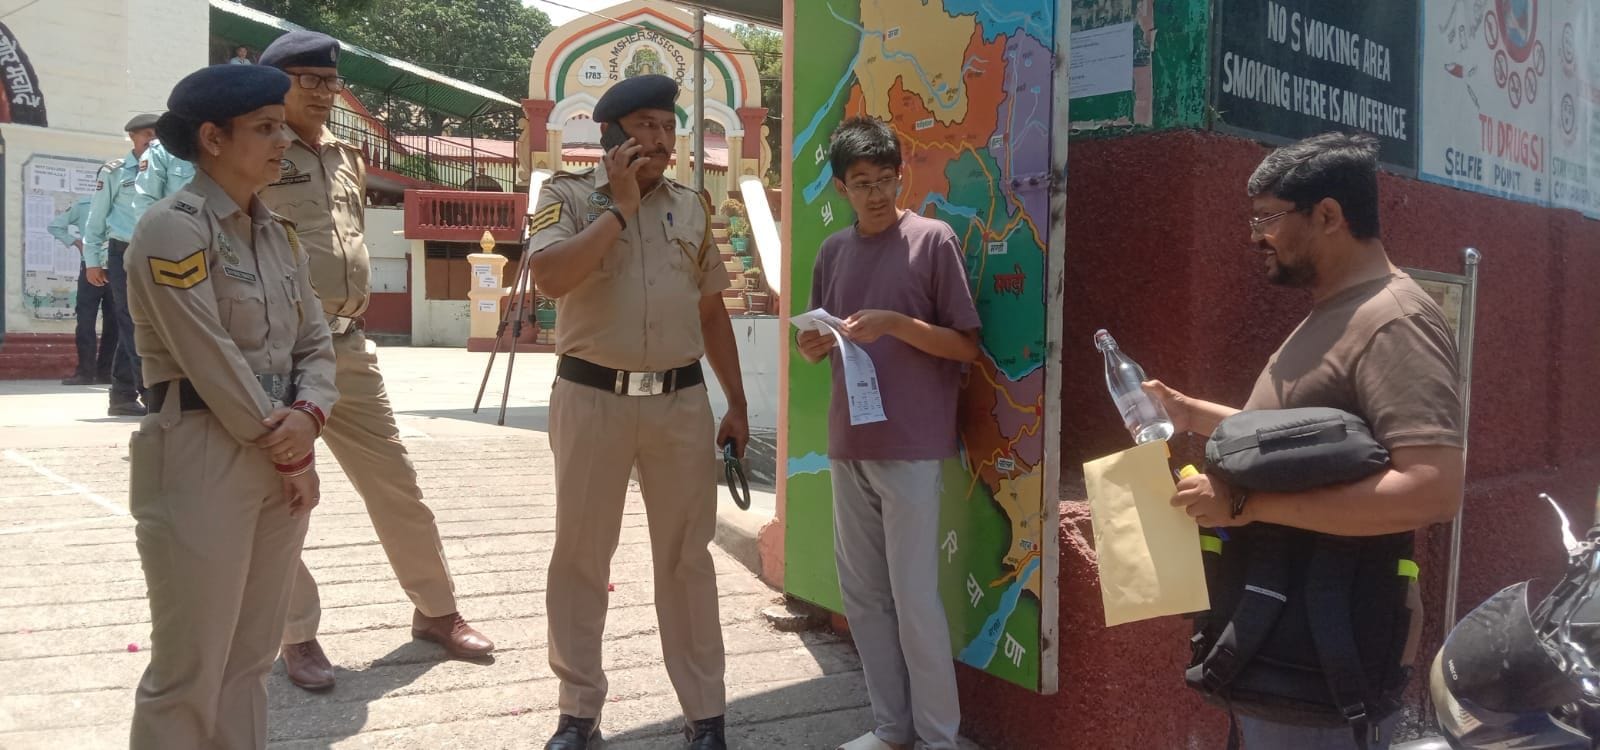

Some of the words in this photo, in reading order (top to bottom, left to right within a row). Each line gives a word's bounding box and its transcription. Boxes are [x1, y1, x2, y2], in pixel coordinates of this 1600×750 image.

[656, 37, 675, 53] SEC
[670, 49, 687, 90] SCHOO
[1267, 0, 1286, 44] NO
[1362, 38, 1391, 82] AREA
[585, 71, 602, 80] 1783
[1222, 51, 1291, 111] SMOKING
[1292, 75, 1327, 120] HERE
[1329, 86, 1341, 123] IS
[1342, 90, 1358, 128] AN
[1359, 95, 1407, 141] OFFENCE
[1444, 147, 1483, 182] SELFIE
[1494, 164, 1521, 192] POINT
[1479, 113, 1493, 153] TO
[1498, 120, 1545, 173] DRUGS!
